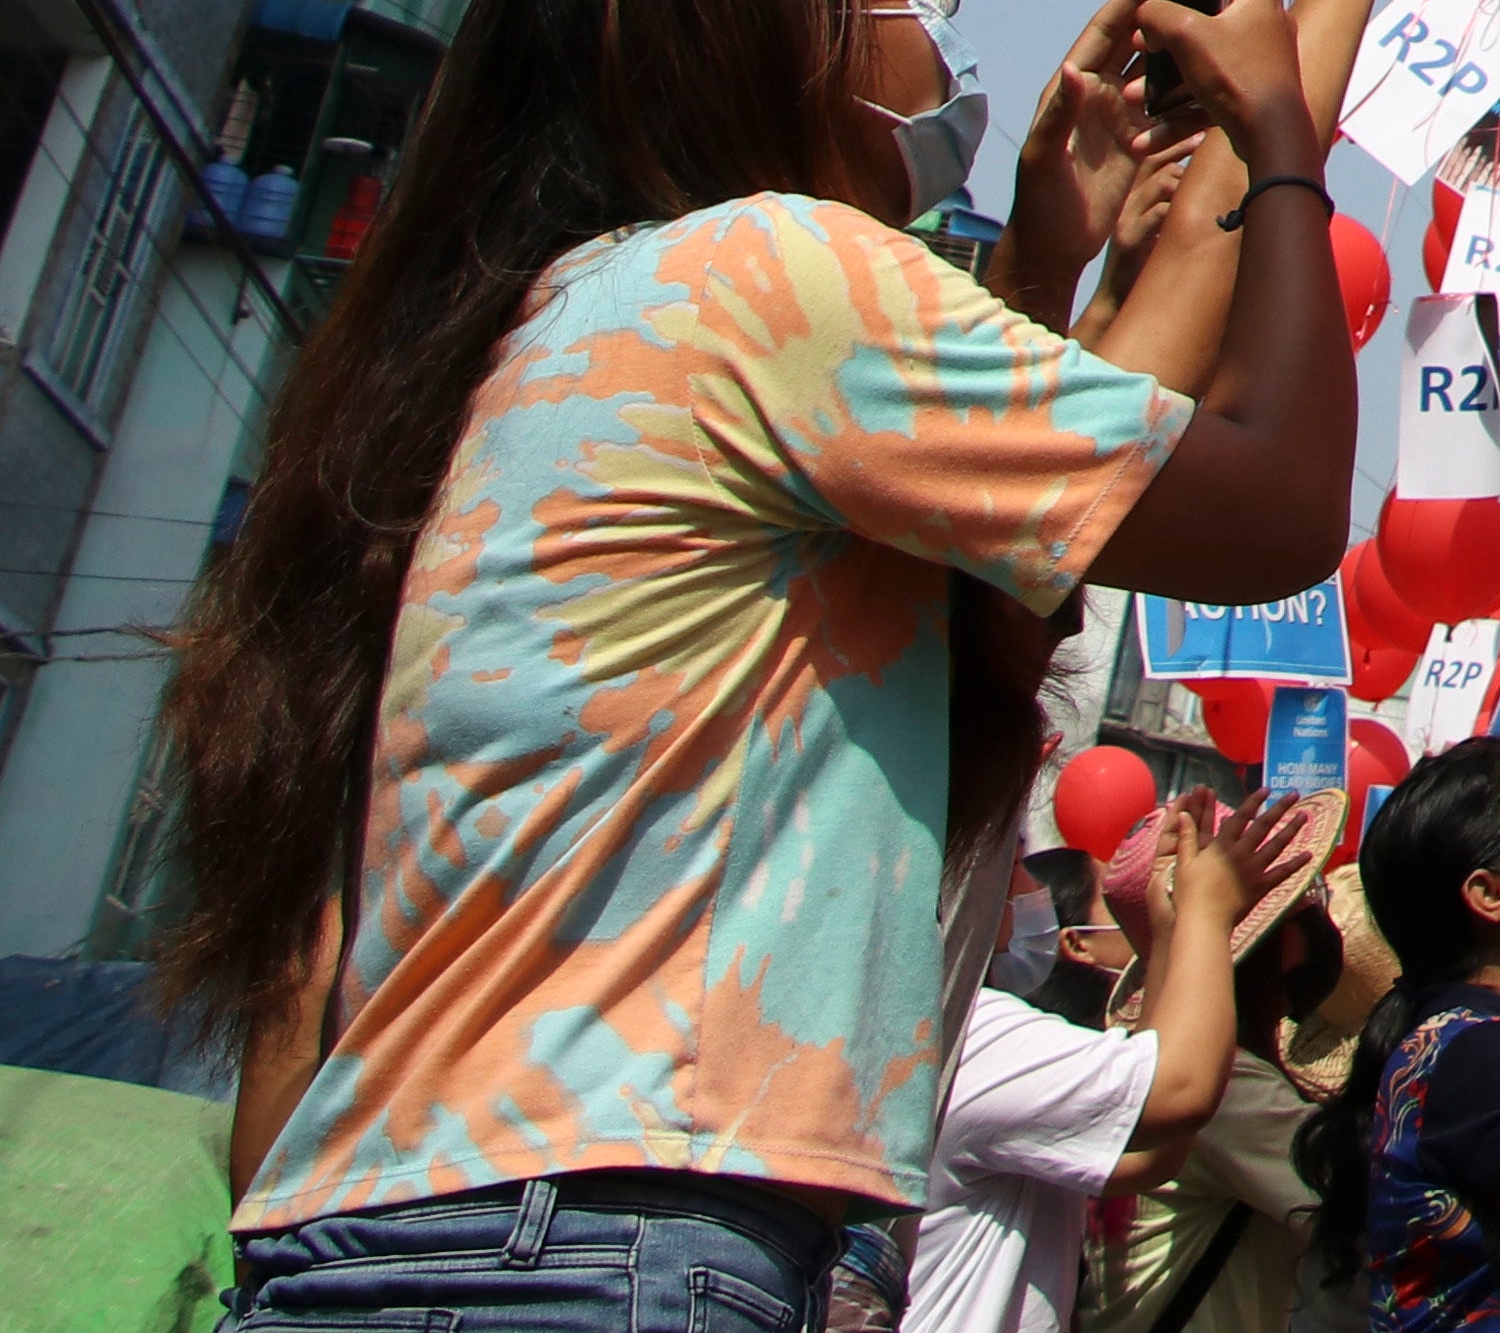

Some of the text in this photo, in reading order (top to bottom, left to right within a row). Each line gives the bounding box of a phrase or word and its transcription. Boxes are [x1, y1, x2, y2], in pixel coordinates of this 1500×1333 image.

[1379, 12, 1488, 97] R2P
[1419, 365, 1498, 412] R2
[1423, 660, 1482, 689] R2P
[1278, 763, 1338, 774] HOW MANY
